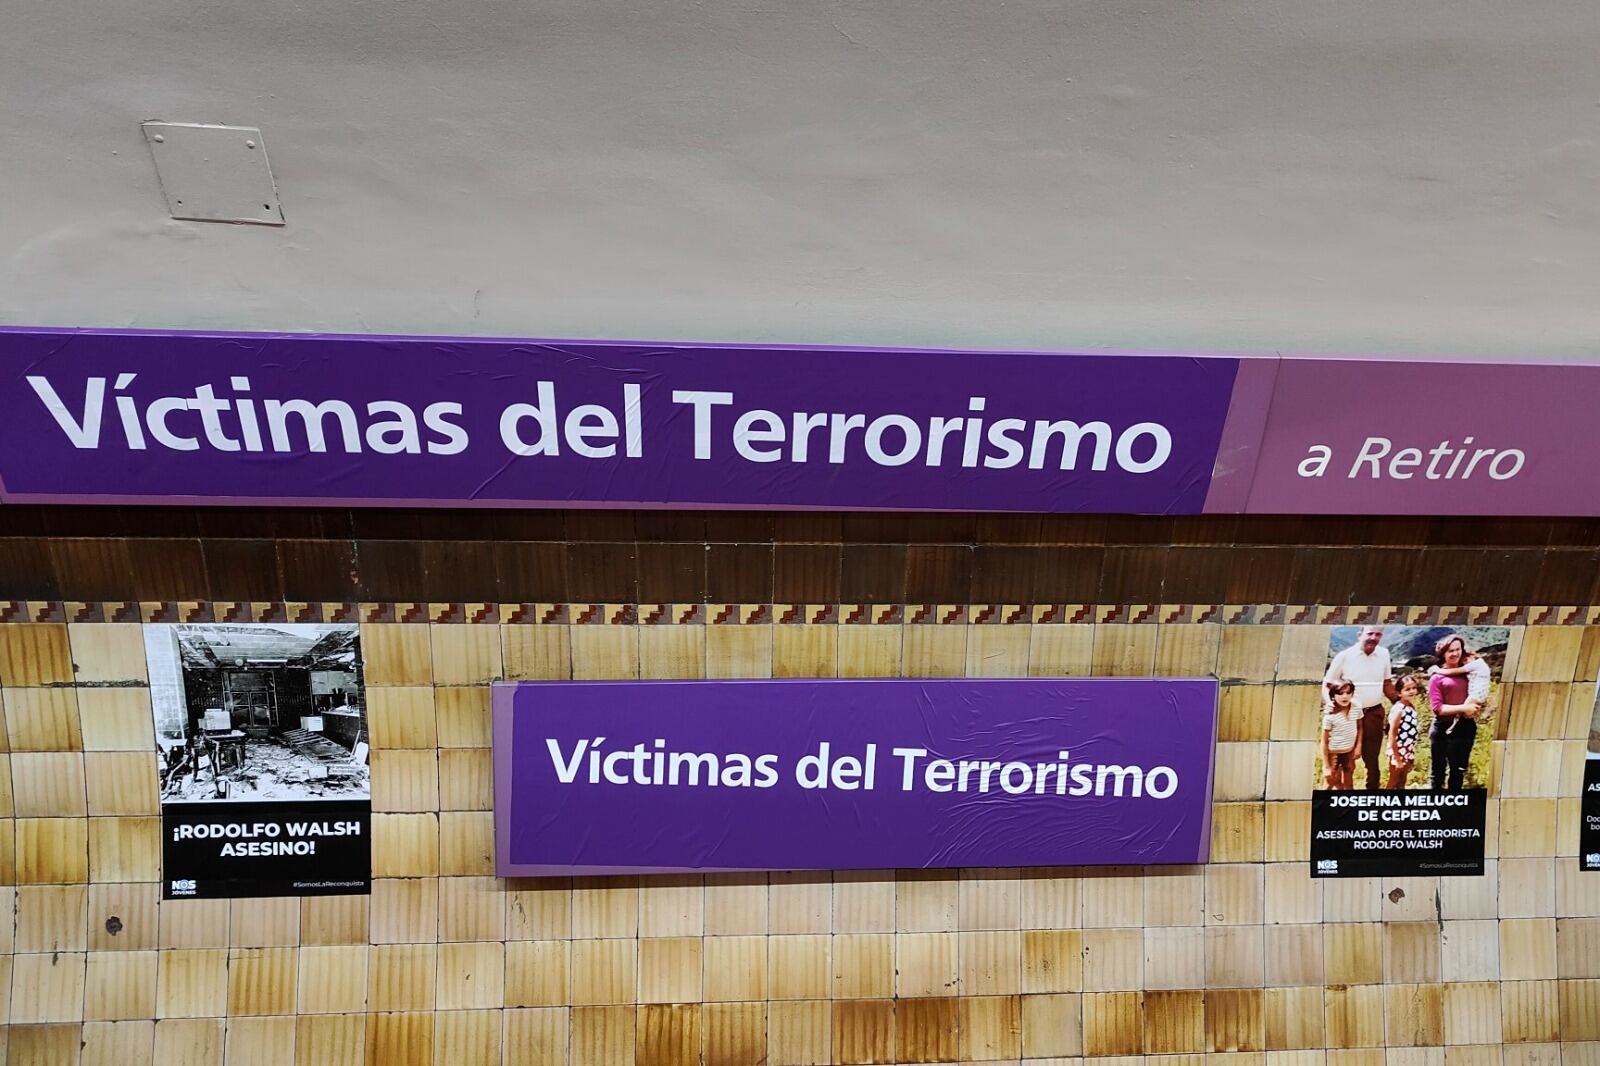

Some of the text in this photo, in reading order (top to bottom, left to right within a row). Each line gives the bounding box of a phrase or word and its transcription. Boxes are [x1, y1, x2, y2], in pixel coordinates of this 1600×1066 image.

[27, 374, 1172, 474] Víctimas del Terrorismo
[1298, 437, 1525, 481] a Retiro
[546, 737, 1178, 800] Víctimas del Terrorismo
[1330, 795, 1469, 807] JOSEFINA MELUCCI
[1357, 809, 1441, 822] DE CEPEDA
[173, 821, 361, 842] ¡RODOLFO WALSH
[1316, 828, 1480, 840] ASESINADA POR EL TERRORISTA
[219, 840, 316, 857] ASESINO!
[1353, 839, 1443, 850] RODOLFO WALSH
[1317, 859, 1338, 870] NOS
[171, 879, 197, 891] NOS
[293, 880, 365, 888] #SomosLaReconquista
